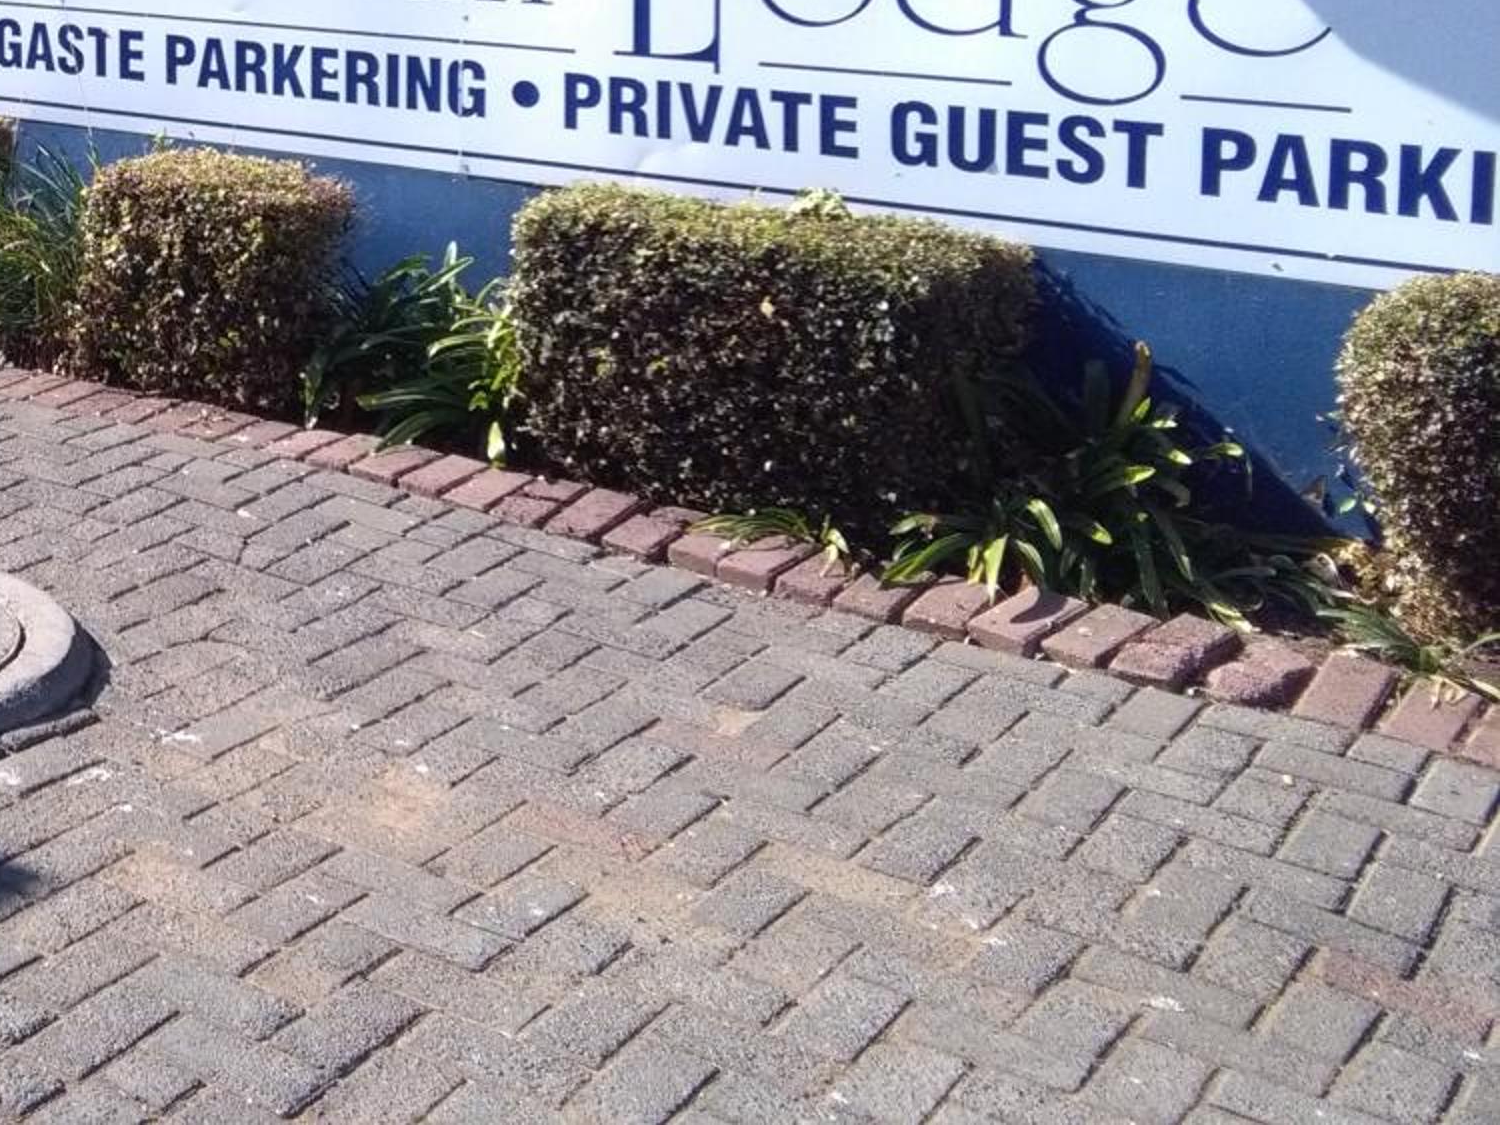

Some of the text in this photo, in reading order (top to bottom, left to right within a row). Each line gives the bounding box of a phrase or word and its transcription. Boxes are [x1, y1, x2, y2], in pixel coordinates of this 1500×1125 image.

[166, 34, 487, 118] PARKERING
[563, 72, 859, 159] PRIVATE
[890, 101, 1165, 189] GUEST
[1199, 127, 1496, 226] PARKI
